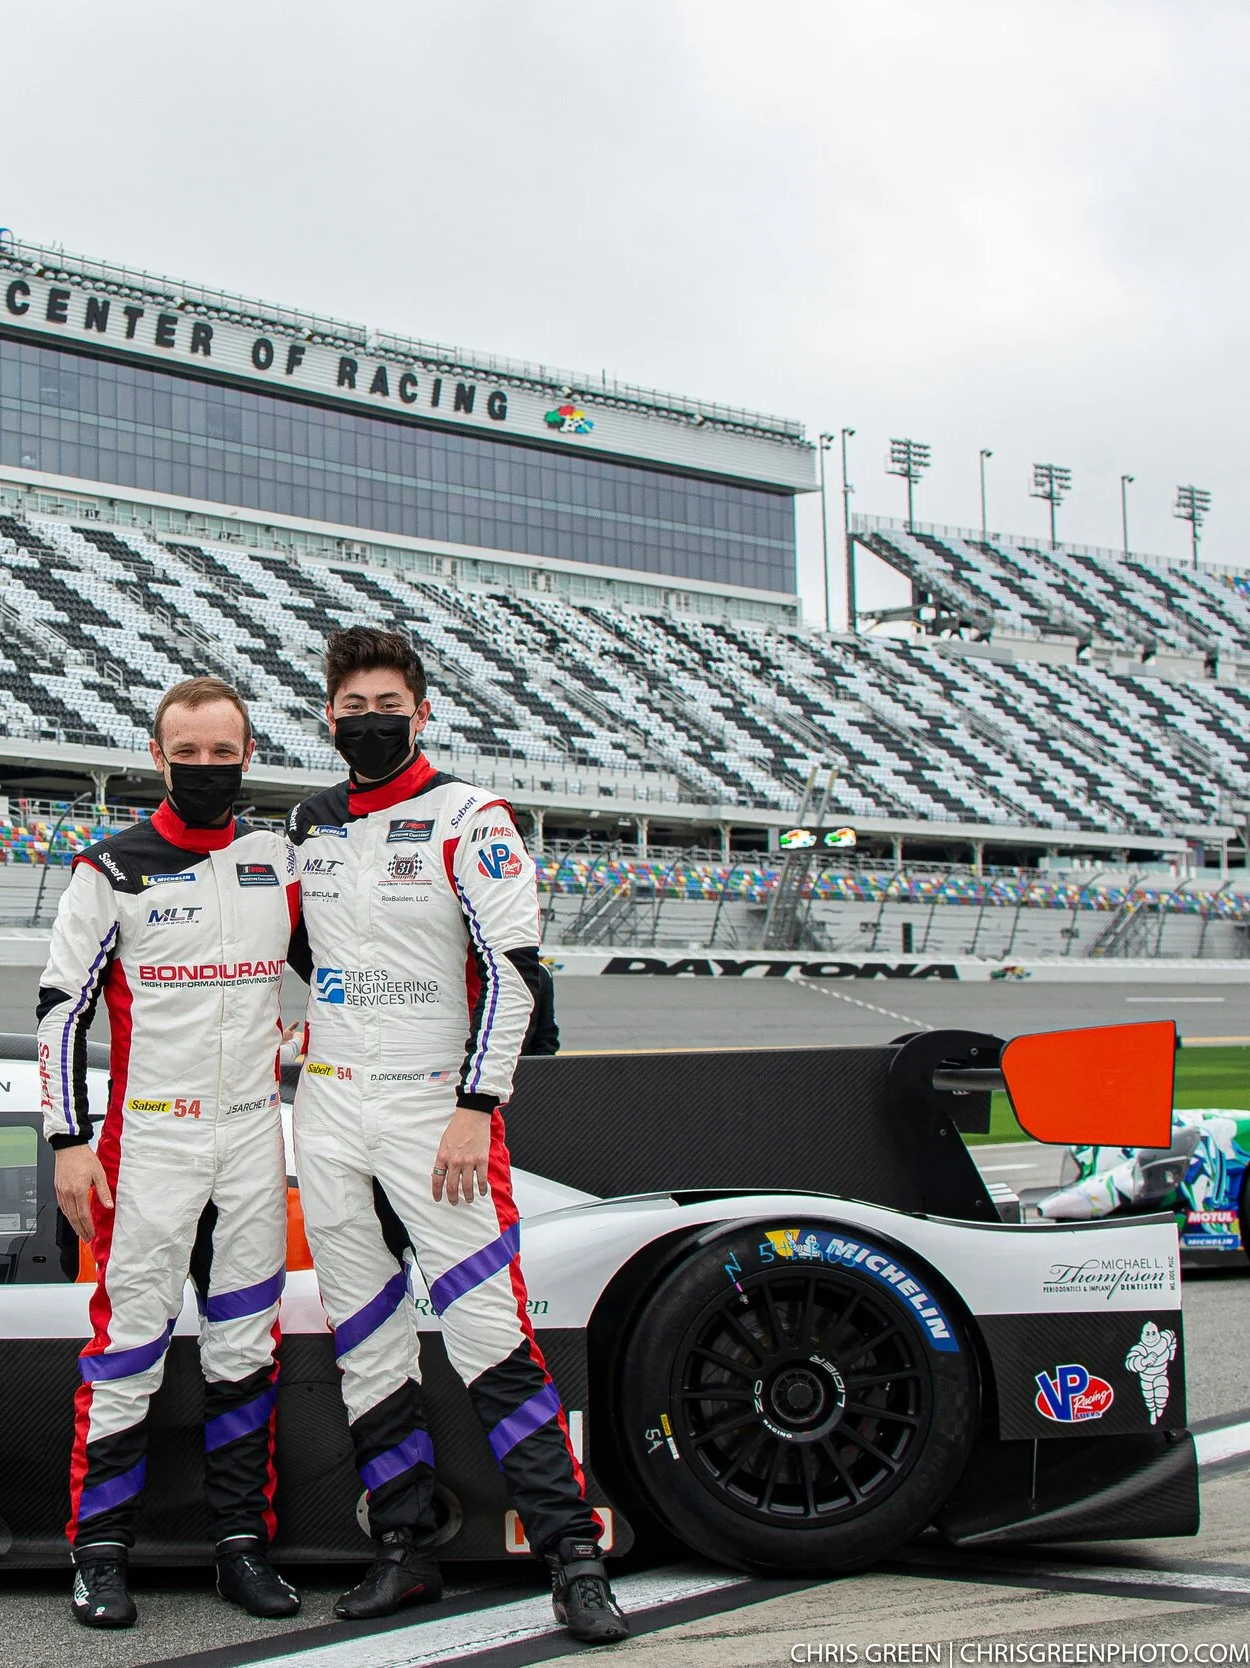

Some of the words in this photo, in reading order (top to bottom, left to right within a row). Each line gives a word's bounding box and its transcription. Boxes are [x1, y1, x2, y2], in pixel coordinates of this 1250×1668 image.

[5, 279, 213, 357] CENTER
[252, 336, 306, 376] OF
[337, 356, 510, 422] RACING
[451, 796, 477, 829] Sabelt
[99, 852, 127, 882] Sabelt
[285, 844, 296, 876] Sabelt
[303, 858, 344, 873] MLT
[478, 843, 510, 879] VP
[397, 862, 411, 874] 31
[304, 890, 339, 899] OLECULE
[148, 907, 203, 923] MLT
[139, 960, 286, 981] BONDURANT
[344, 970, 389, 982] STRESS
[600, 957, 961, 980] DAYTONA
[140, 980, 162, 988] HIGH
[163, 980, 236, 989] PERFORMANCE
[237, 976, 268, 985] DRIVING
[344, 980, 439, 995] ENGINEERING
[347, 993, 406, 1007] SERVICES
[409, 992, 440, 1004] INC.
[307, 1063, 332, 1076] Sabelt
[337, 1066, 352, 1080] 54
[131, 1099, 168, 1112] Sabelt
[173, 1098, 201, 1119] 54
[1188, 1211, 1233, 1222] MOTUL
[1101, 1258, 1151, 1270] MICHAEL
[1155, 1258, 1163, 1269] L.
[1043, 1259, 1167, 1300] Thompson
[1121, 1283, 1163, 1291] DENTISTRY
[825, 1237, 951, 1340] MICHELIN
[1035, 1364, 1090, 1422] VP
[763, 1419, 793, 1439] RACING
